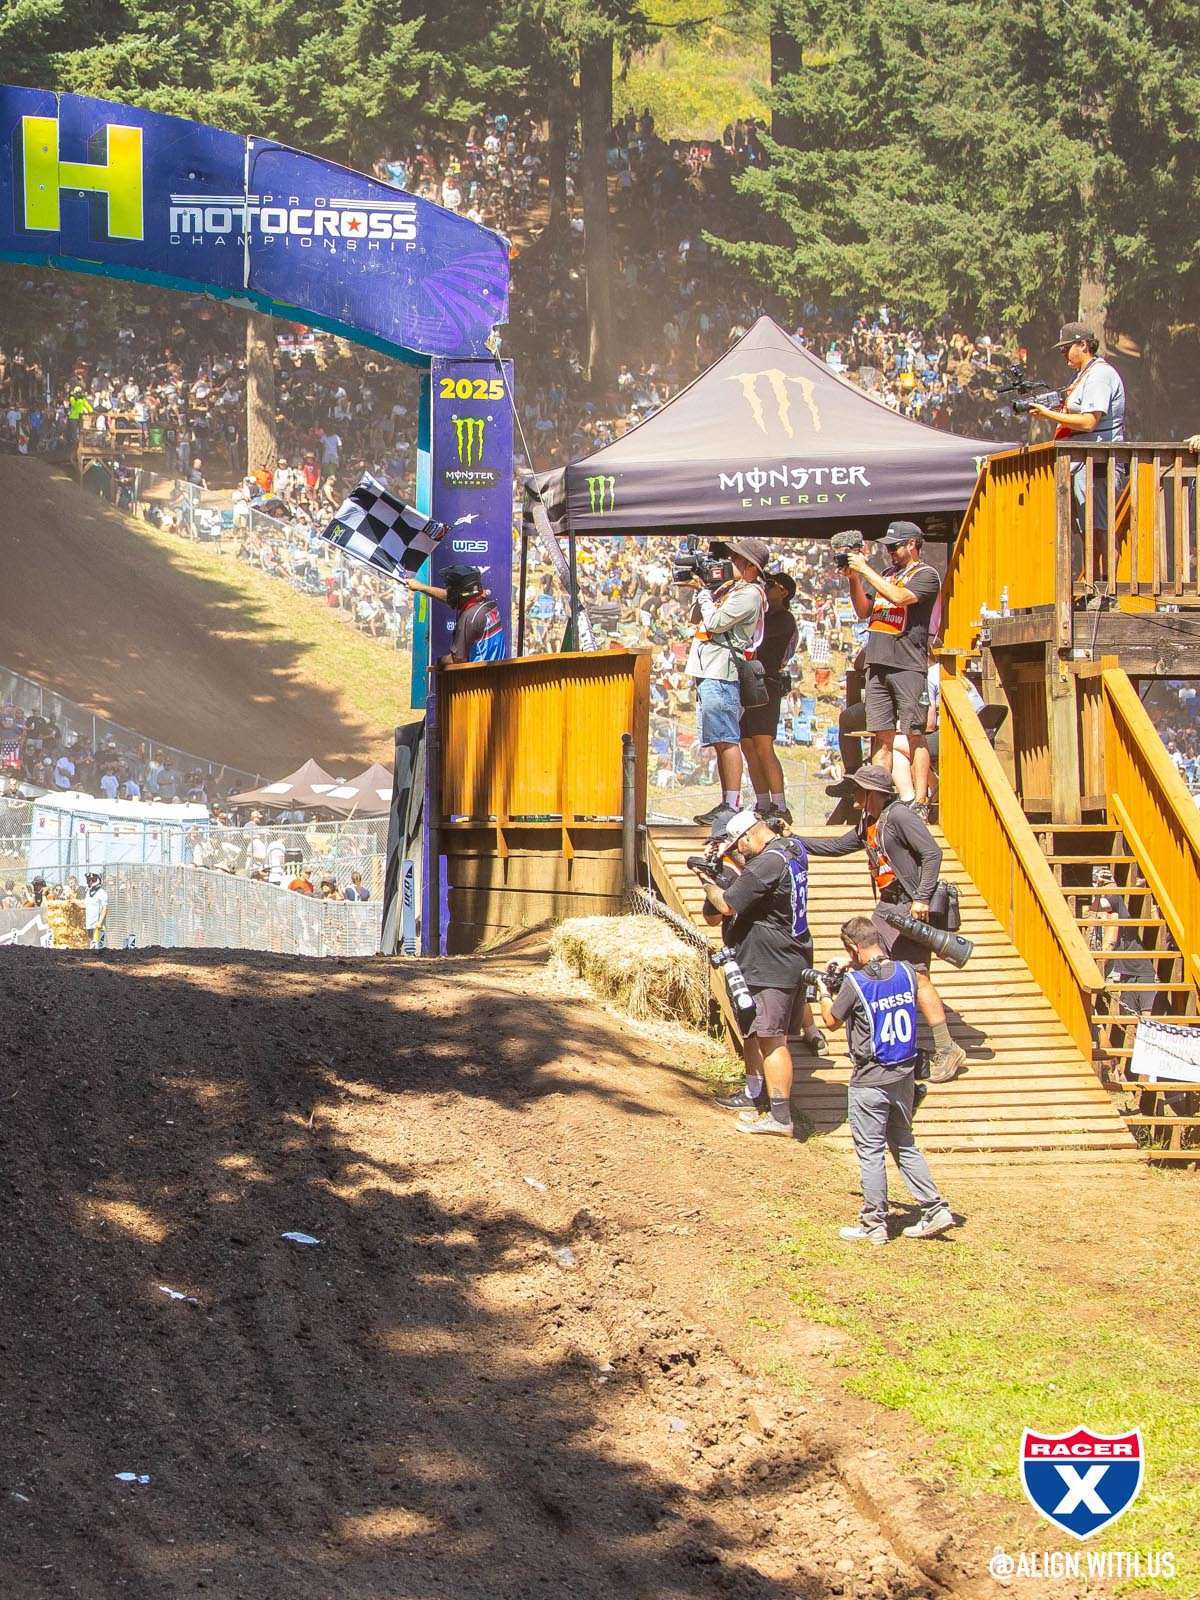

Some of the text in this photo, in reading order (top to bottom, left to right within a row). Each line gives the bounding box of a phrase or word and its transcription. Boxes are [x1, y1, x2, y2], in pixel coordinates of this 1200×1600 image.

[263, 195, 327, 208] PRO
[169, 206, 418, 241] MOTOCROSS
[169, 234, 417, 253] CHAMPIONSHIP
[439, 377, 505, 400] 2025
[446, 470, 494, 480] MONSTER
[718, 465, 871, 494] MONSTER
[742, 493, 847, 508] ENERGY
[453, 540, 489, 553] WPS
[871, 992, 913, 1014] PRESS
[880, 1008, 912, 1046] 40
